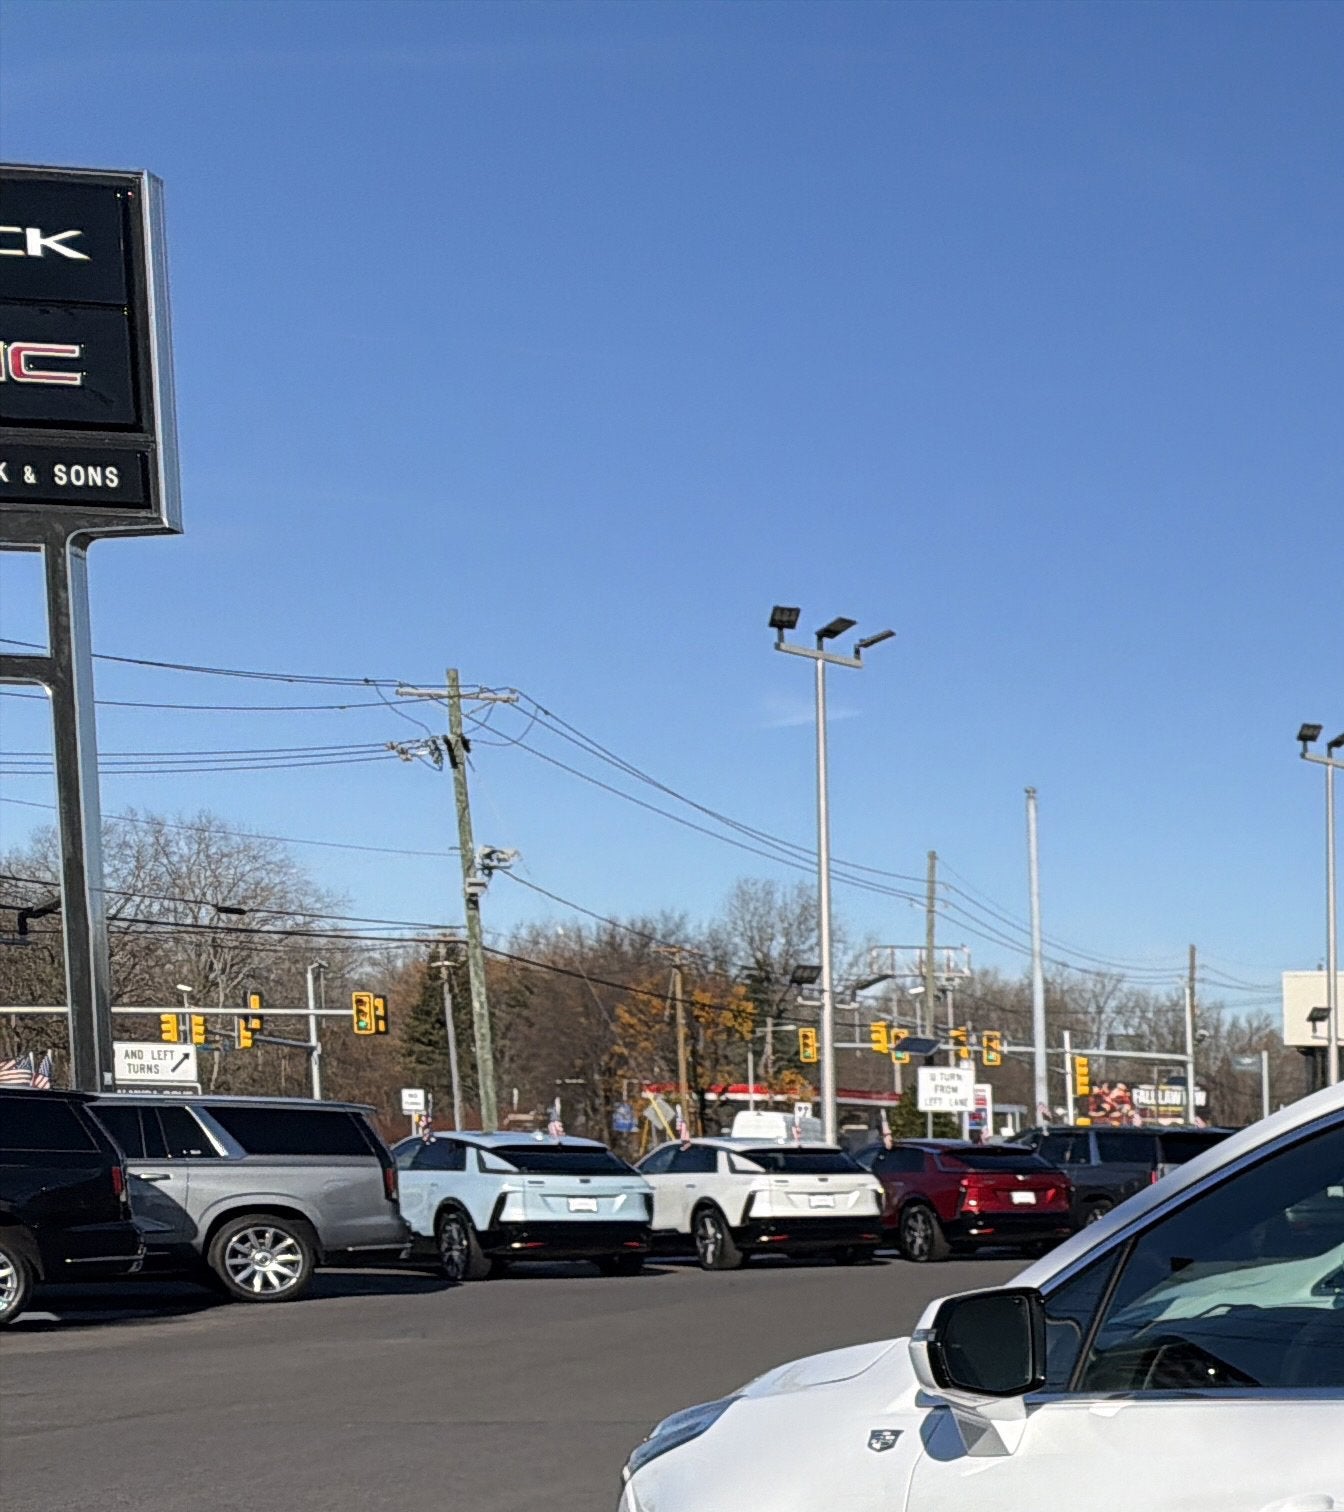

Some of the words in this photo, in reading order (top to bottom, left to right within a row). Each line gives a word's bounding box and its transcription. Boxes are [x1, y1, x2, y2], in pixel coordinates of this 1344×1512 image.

[0, 341, 82, 385] C
[24, 465, 37, 484] &
[53, 464, 119, 488] SONS
[124, 1049, 144, 1060] AND
[151, 1050, 175, 1060] LEFT
[127, 1063, 160, 1075] TURNS
[934, 1084, 958, 1095] FROM
[924, 1096, 942, 1107] LEFT
[949, 1098, 969, 1108] LANE
